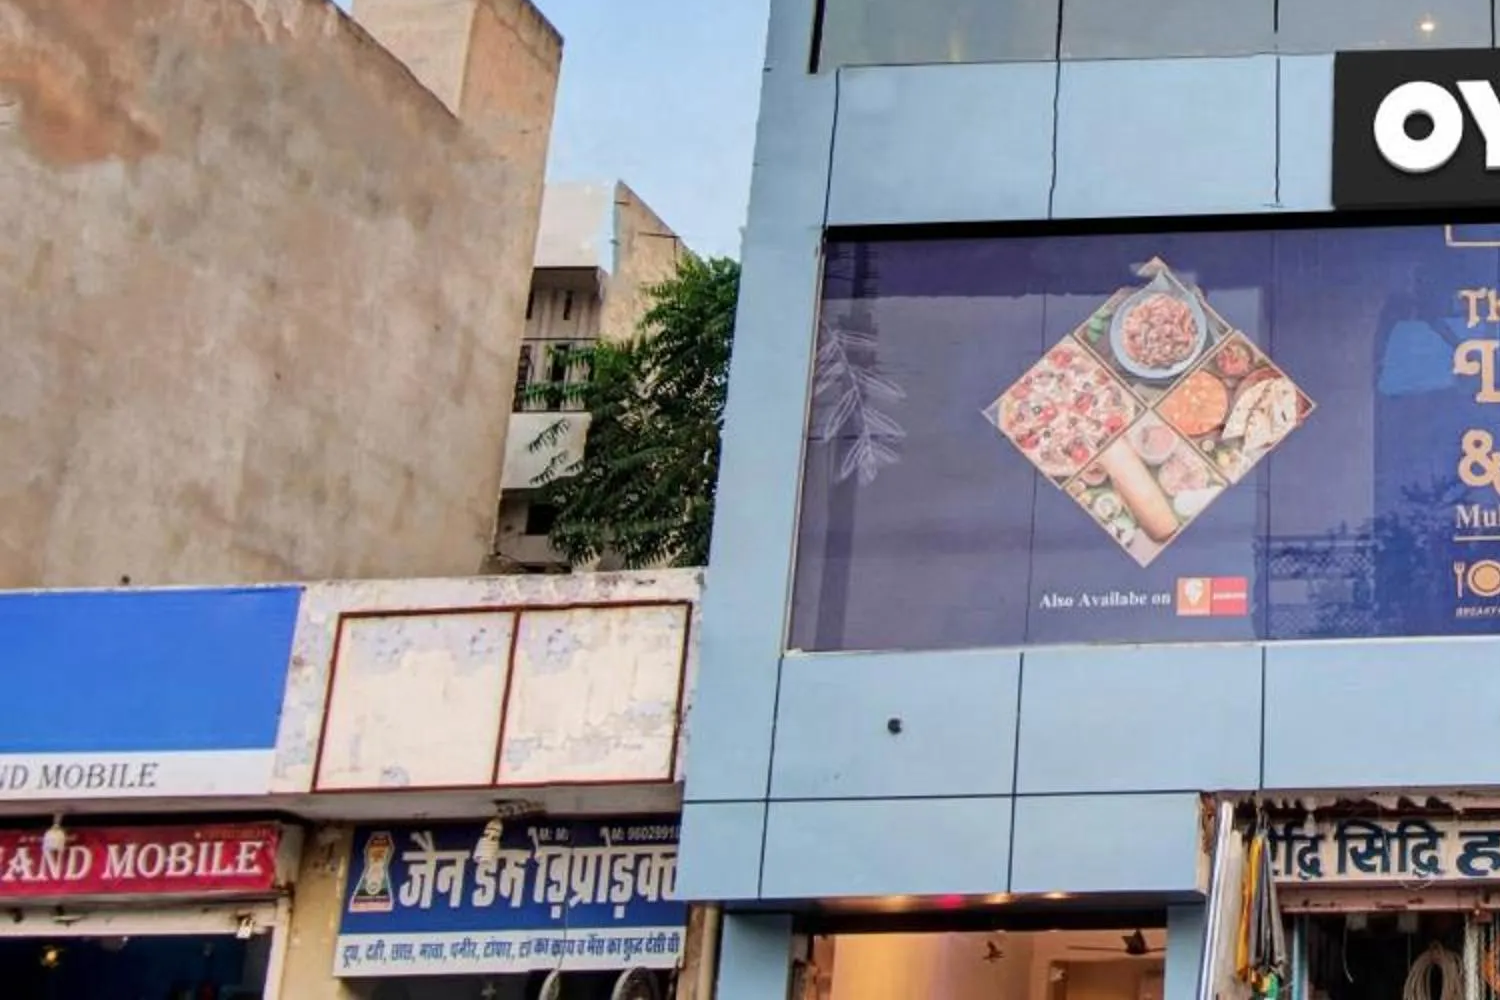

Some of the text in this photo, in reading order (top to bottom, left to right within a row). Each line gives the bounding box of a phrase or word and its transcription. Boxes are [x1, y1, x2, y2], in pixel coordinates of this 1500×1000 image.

[1040, 593, 1074, 608] Also
[1152, 592, 1171, 605] on
[38, 762, 159, 789] MOBILE
[0, 840, 263, 881] AND MOBILE
[400, 832, 471, 909] जैन
